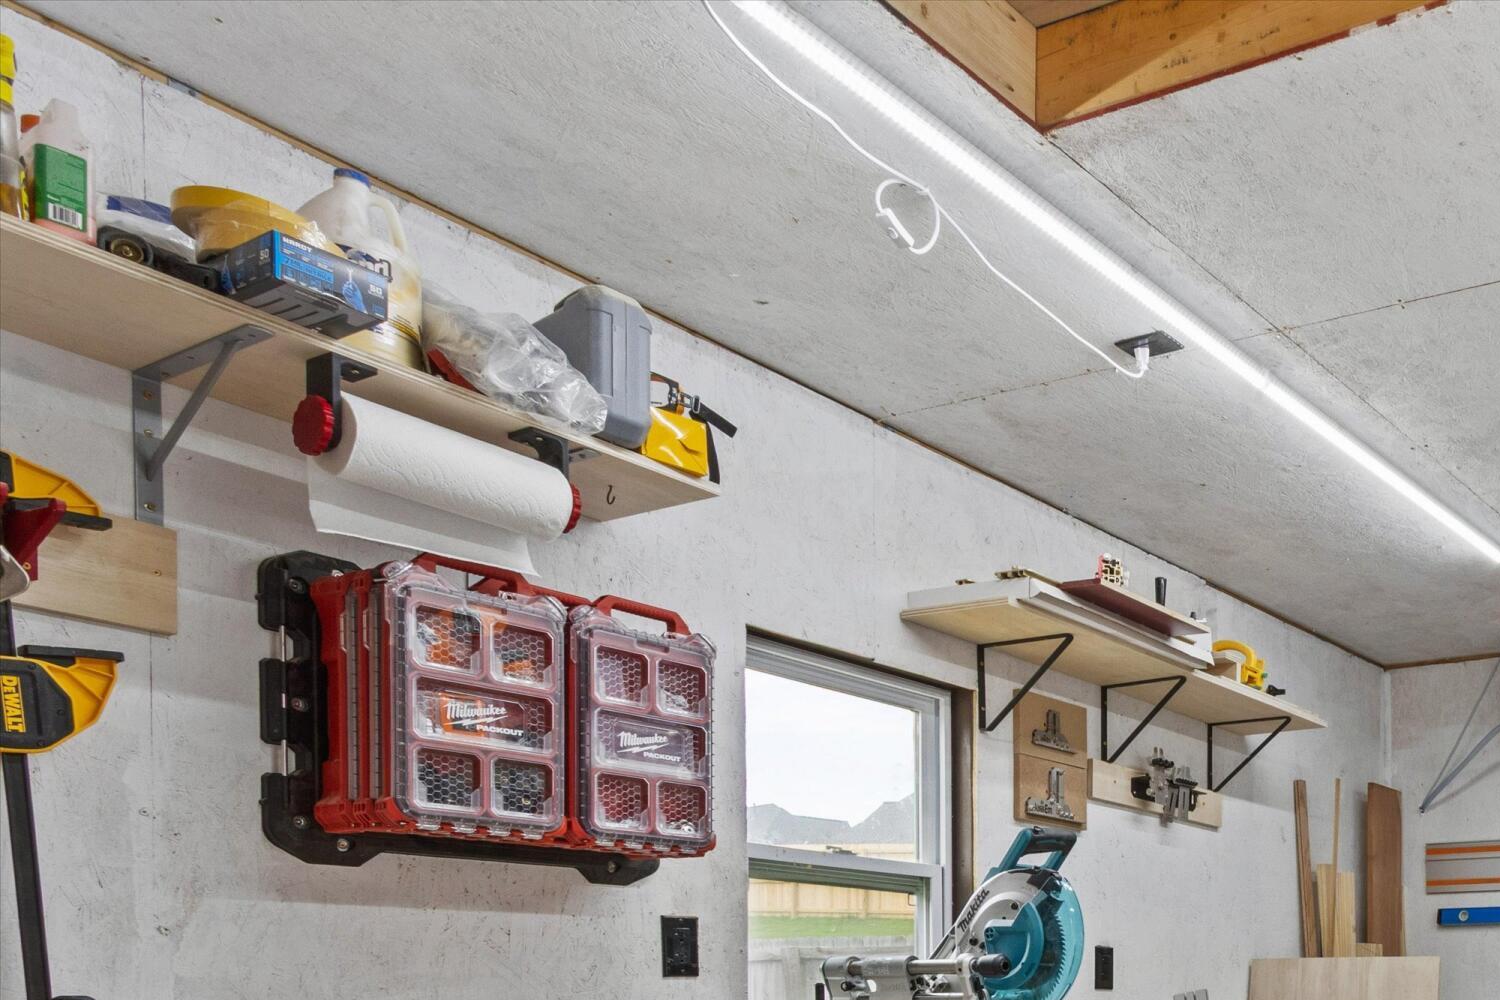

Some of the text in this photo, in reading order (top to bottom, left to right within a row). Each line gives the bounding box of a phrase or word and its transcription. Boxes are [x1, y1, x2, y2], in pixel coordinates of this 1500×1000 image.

[442, 701, 508, 720] Milwaukee
[476, 724, 524, 736] PACKOUT
[617, 731, 669, 748] Milwaukee
[643, 751, 682, 762] PACKOUT
